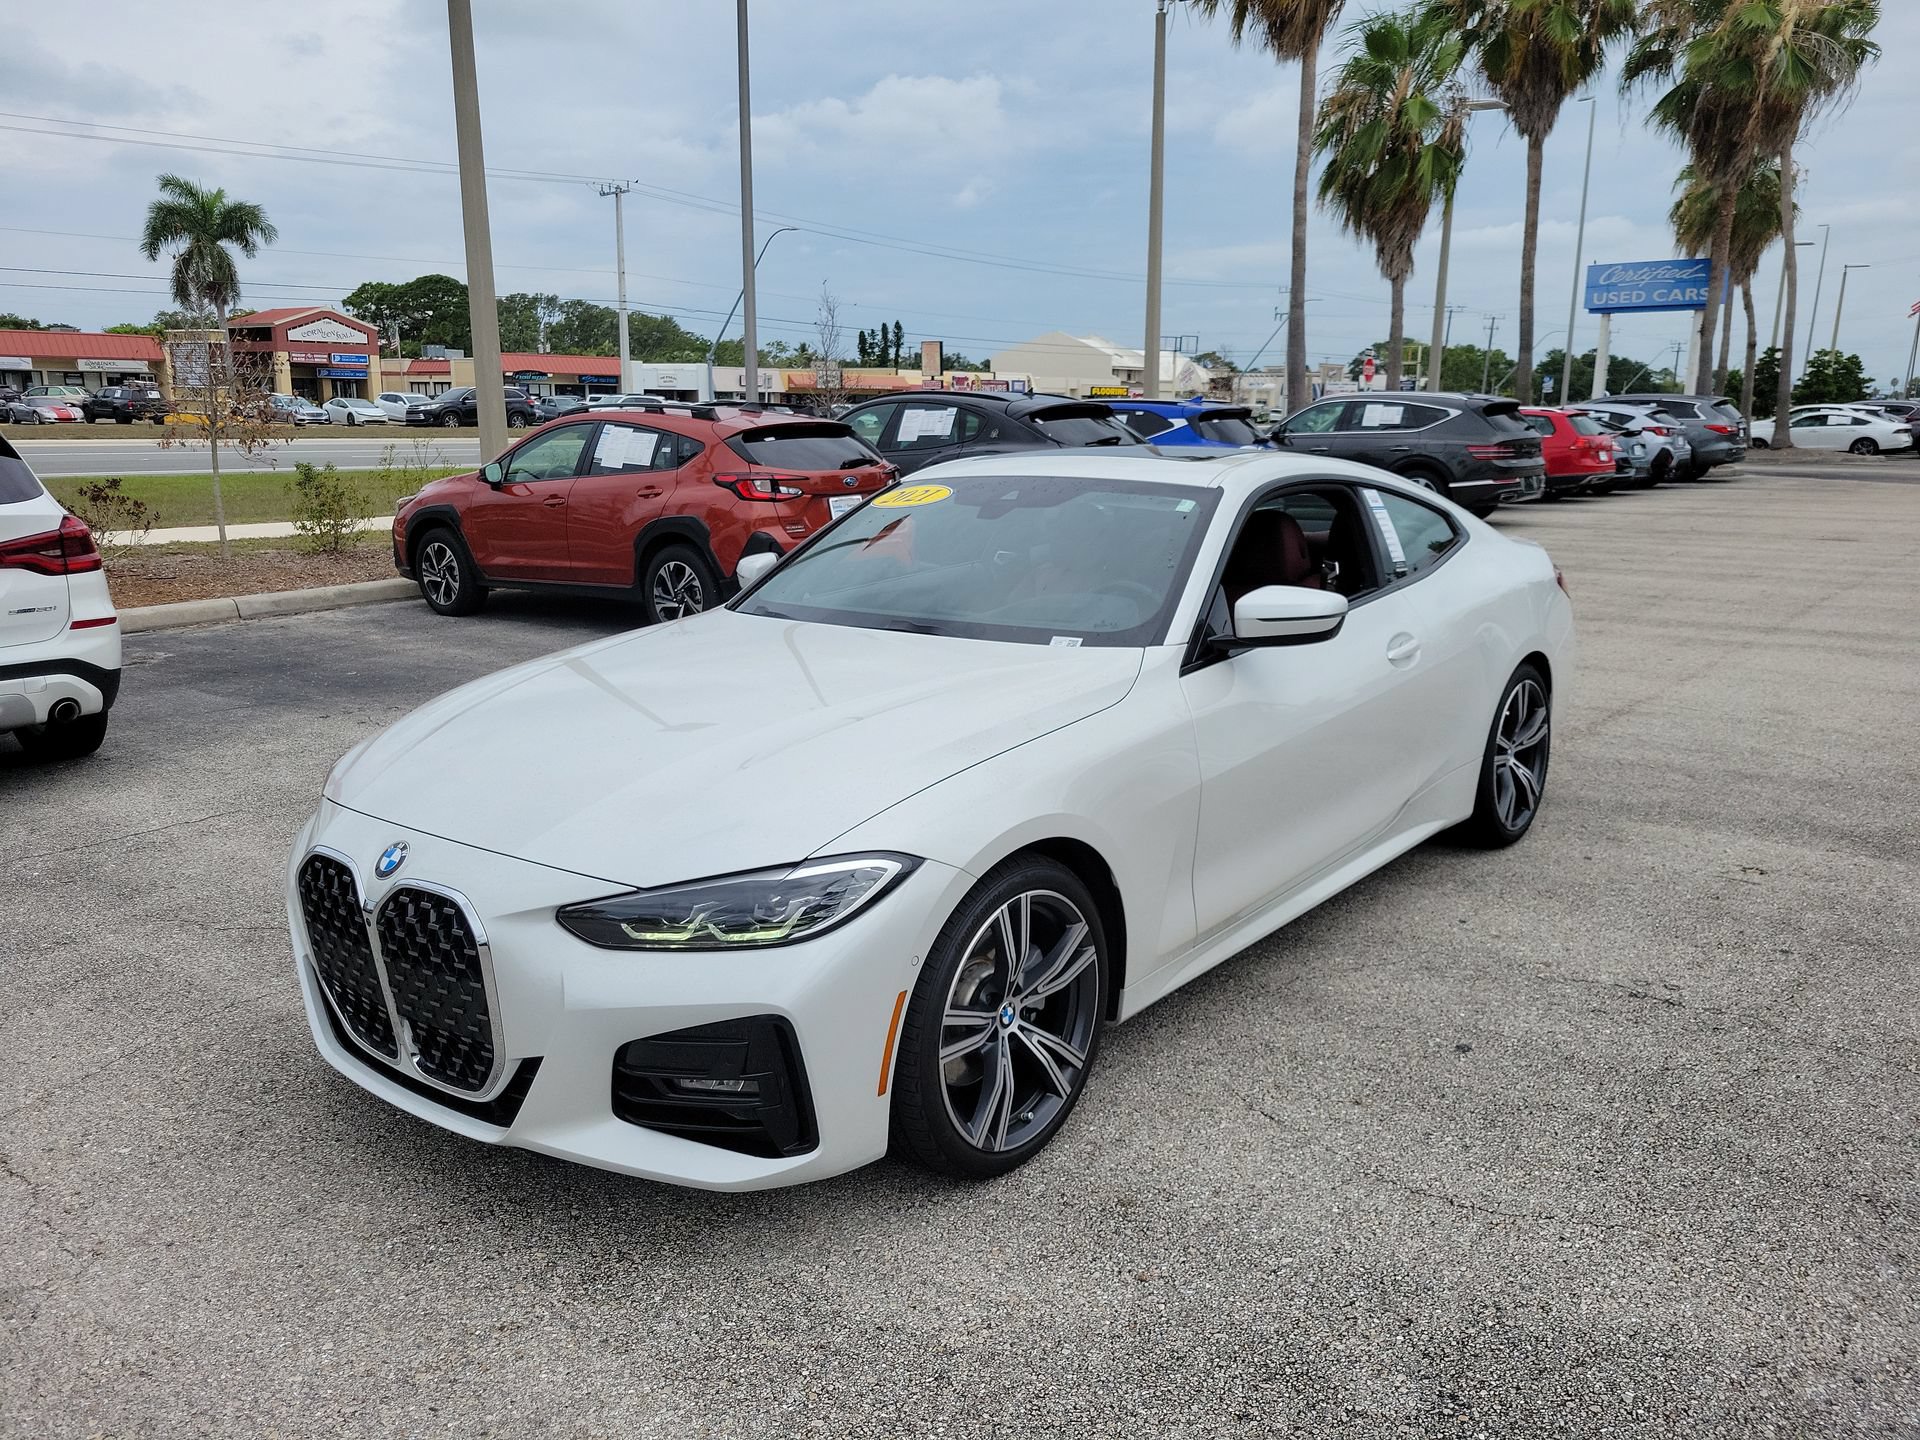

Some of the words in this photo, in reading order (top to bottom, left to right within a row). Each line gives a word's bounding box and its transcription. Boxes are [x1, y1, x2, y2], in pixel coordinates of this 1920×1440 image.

[1598, 264, 1706, 287] Certified
[1592, 290, 1647, 304] USED
[1652, 287, 1709, 302] CARS
[1092, 387, 1128, 396] FLOORING
